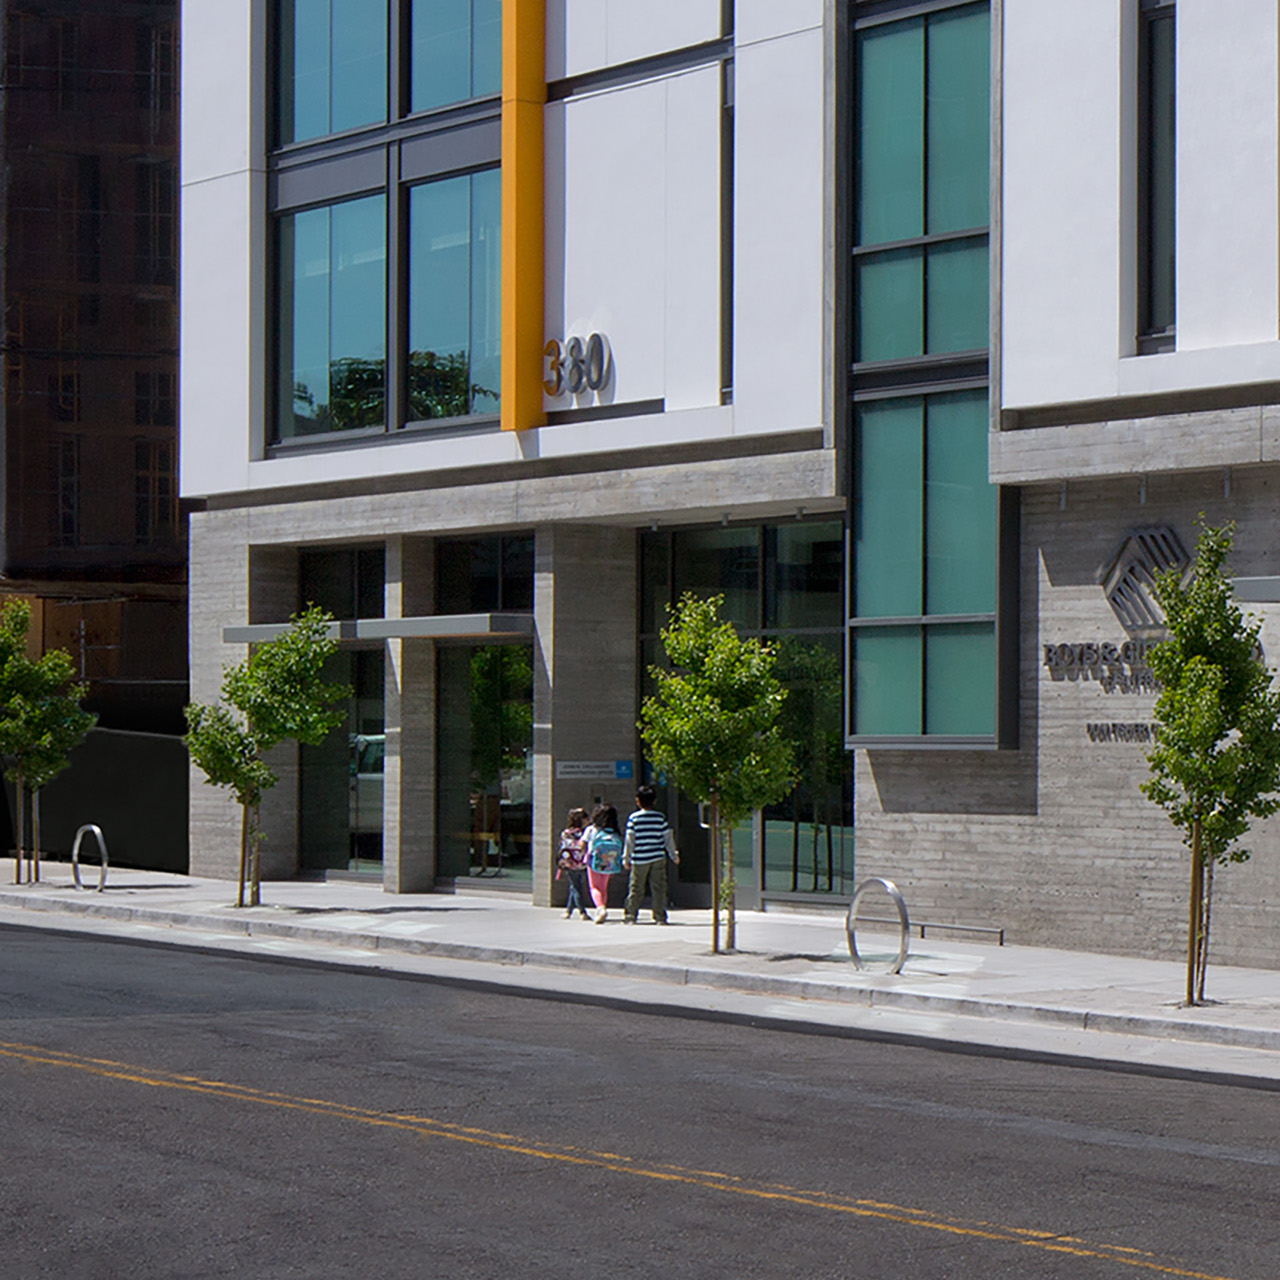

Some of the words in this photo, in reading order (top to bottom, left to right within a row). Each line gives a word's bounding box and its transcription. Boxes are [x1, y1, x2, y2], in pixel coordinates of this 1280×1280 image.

[543, 333, 611, 396] 380
[1043, 643, 1099, 666] BOYS
[1100, 642, 1120, 665] &
